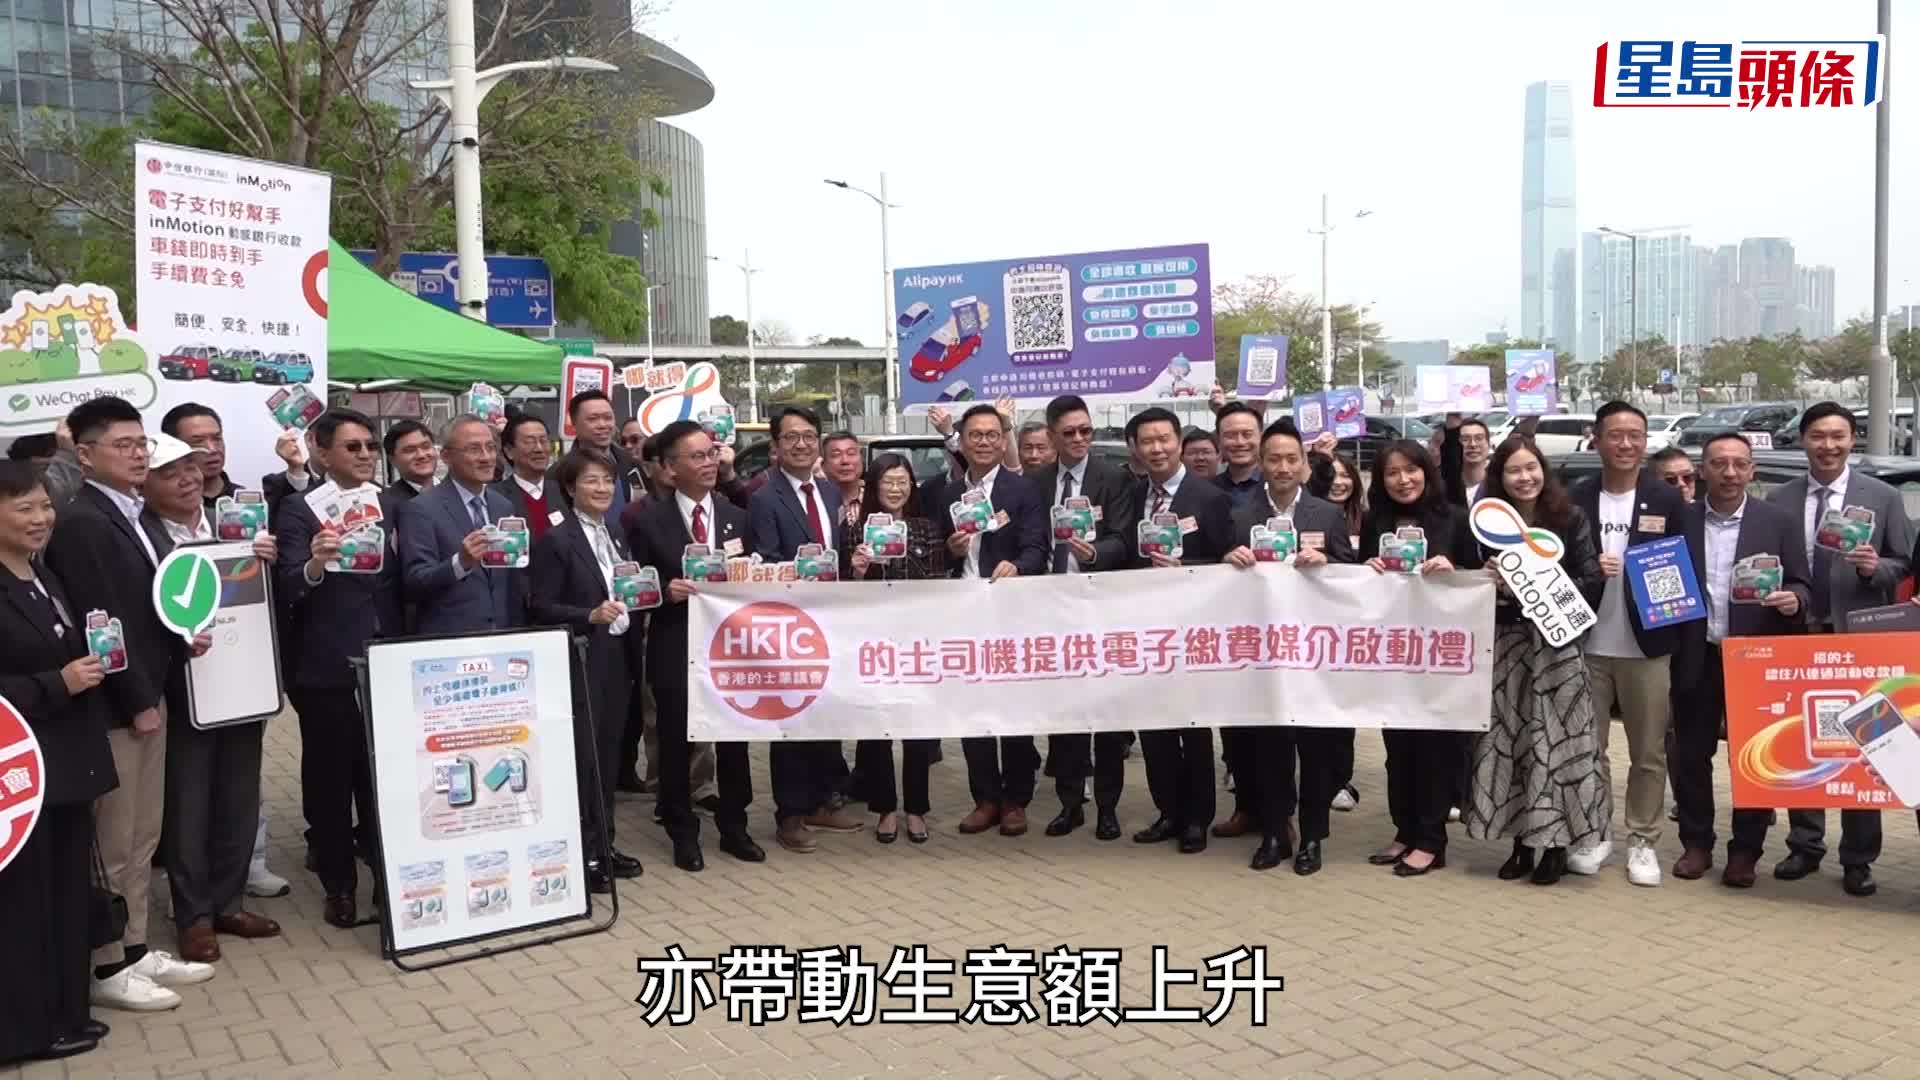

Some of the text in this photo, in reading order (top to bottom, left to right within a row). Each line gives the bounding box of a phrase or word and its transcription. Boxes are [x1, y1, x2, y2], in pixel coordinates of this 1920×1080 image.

[236, 173, 291, 192] inMotion
[148, 189, 283, 224] 電子支付好幫手
[149, 214, 225, 236] inMotion
[151, 236, 264, 266] 車錢即時到手
[151, 261, 246, 289] 手續費全免
[35, 391, 90, 407] WeChat
[1599, 520, 1631, 536] ipay
[1499, 551, 1567, 643] Octopus
[1536, 567, 1592, 631] 八達通
[723, 616, 816, 659] HKTC
[858, 624, 1469, 680] 的士司機提供電子繳費媒介啟動禮
[463, 663, 488, 672] TAXI
[0, 767, 33, 797] 會
